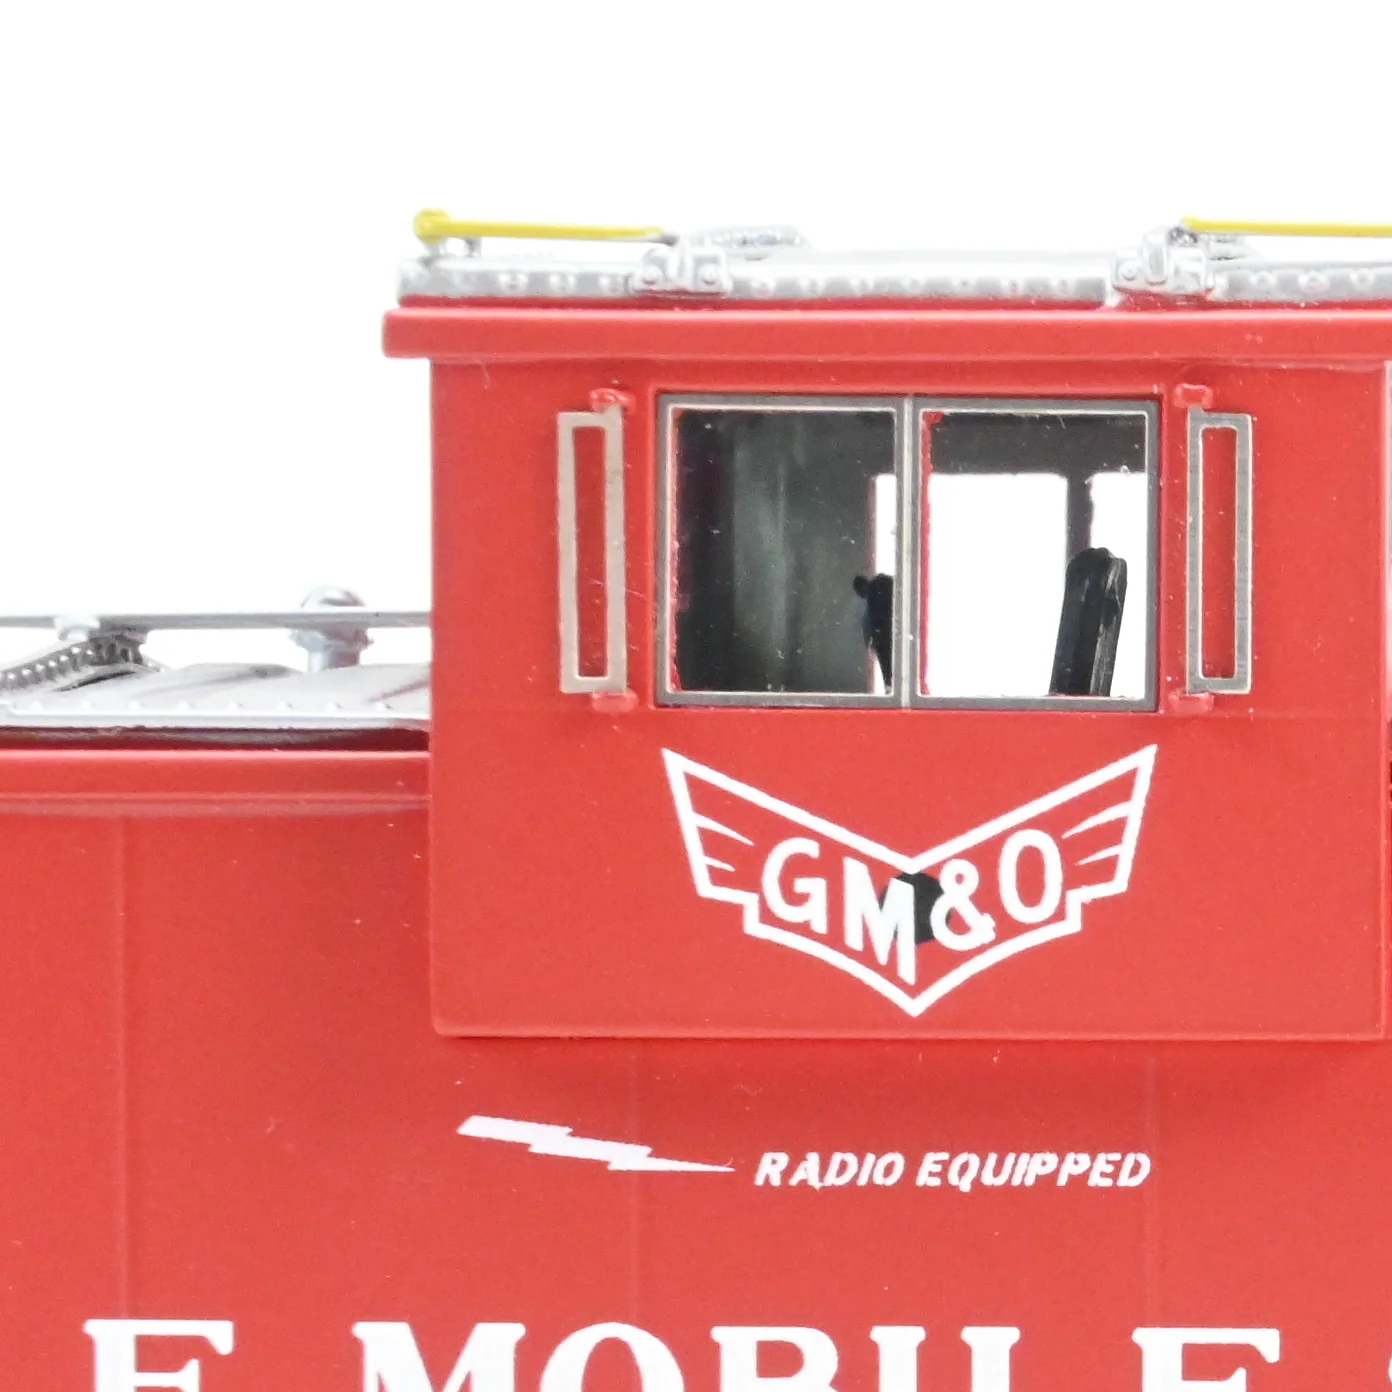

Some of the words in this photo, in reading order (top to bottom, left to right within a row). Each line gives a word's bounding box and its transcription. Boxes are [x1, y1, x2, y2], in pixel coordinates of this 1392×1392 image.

[759, 828, 1064, 986] GM&O
[754, 1151, 905, 1190] RADIO
[915, 1151, 1152, 1193] EQUIPPED
